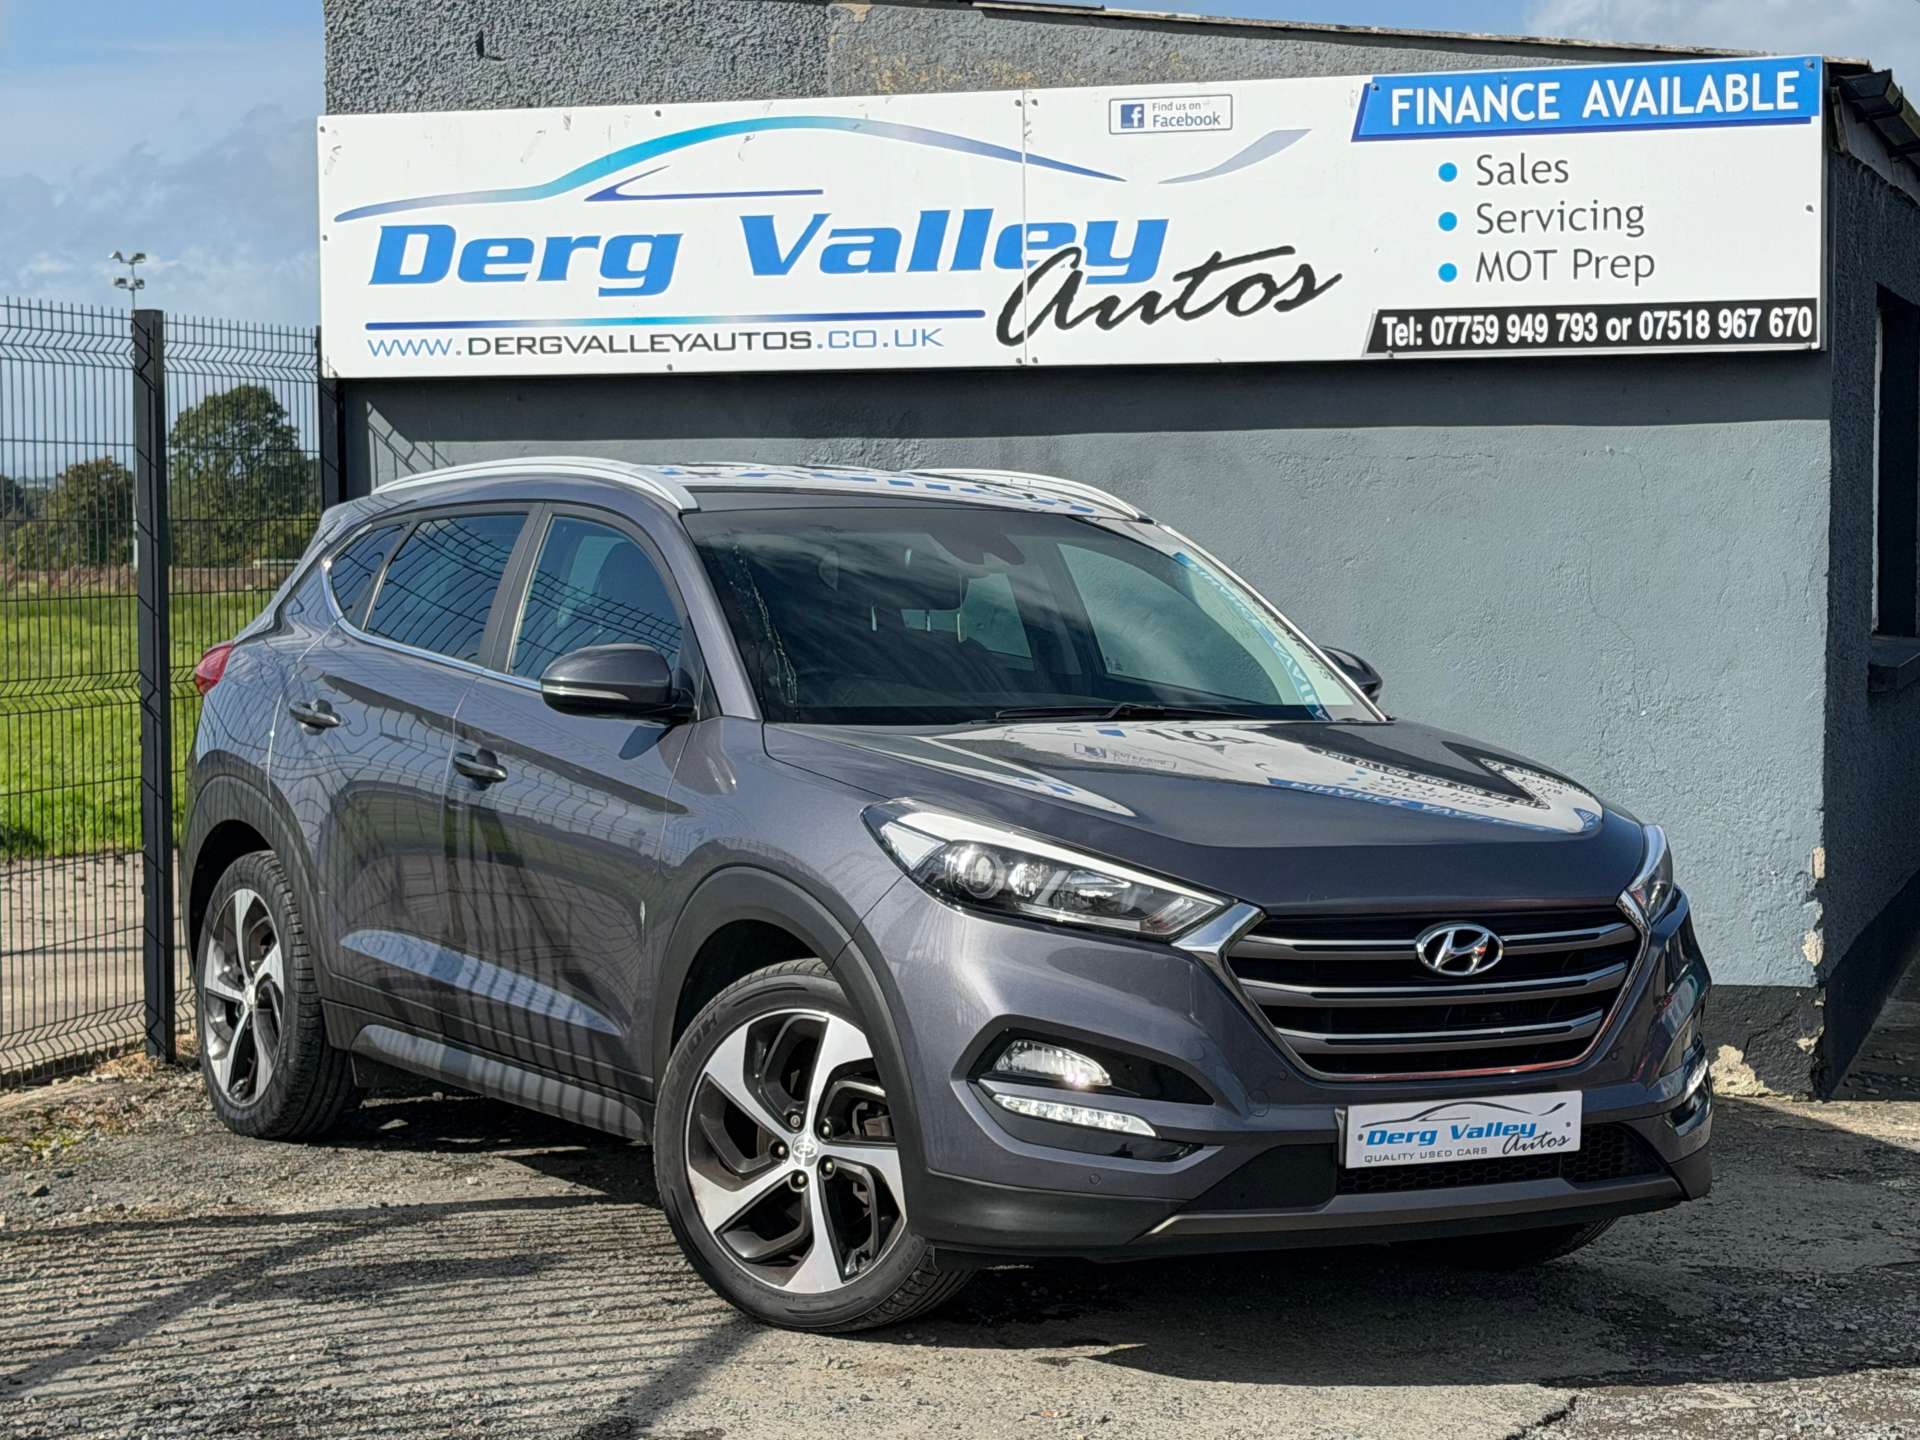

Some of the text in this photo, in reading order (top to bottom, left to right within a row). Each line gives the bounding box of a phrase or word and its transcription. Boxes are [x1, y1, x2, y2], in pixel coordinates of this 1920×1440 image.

[1152, 102, 1201, 112] Find us on
[1390, 70, 1800, 126] FINANCE AVAILABLE
[1152, 111, 1221, 128] Facebook
[1475, 152, 1570, 186] Sales
[1475, 199, 1646, 238] Servicing
[367, 208, 1170, 298] Derg Valley
[1475, 248, 1656, 287] MOT Prep
[996, 244, 1344, 348] Autos
[366, 328, 945, 359] WWW.DERGVALLEYAUTOS.CO.UK
[1381, 306, 1814, 347] Tel: 07759 949 793 or 07518 967 670
[1365, 1121, 1537, 1146] Derg Valley
[1501, 1131, 1571, 1155] Autos
[1364, 1146, 1488, 1164] QUALITY USED CARS
